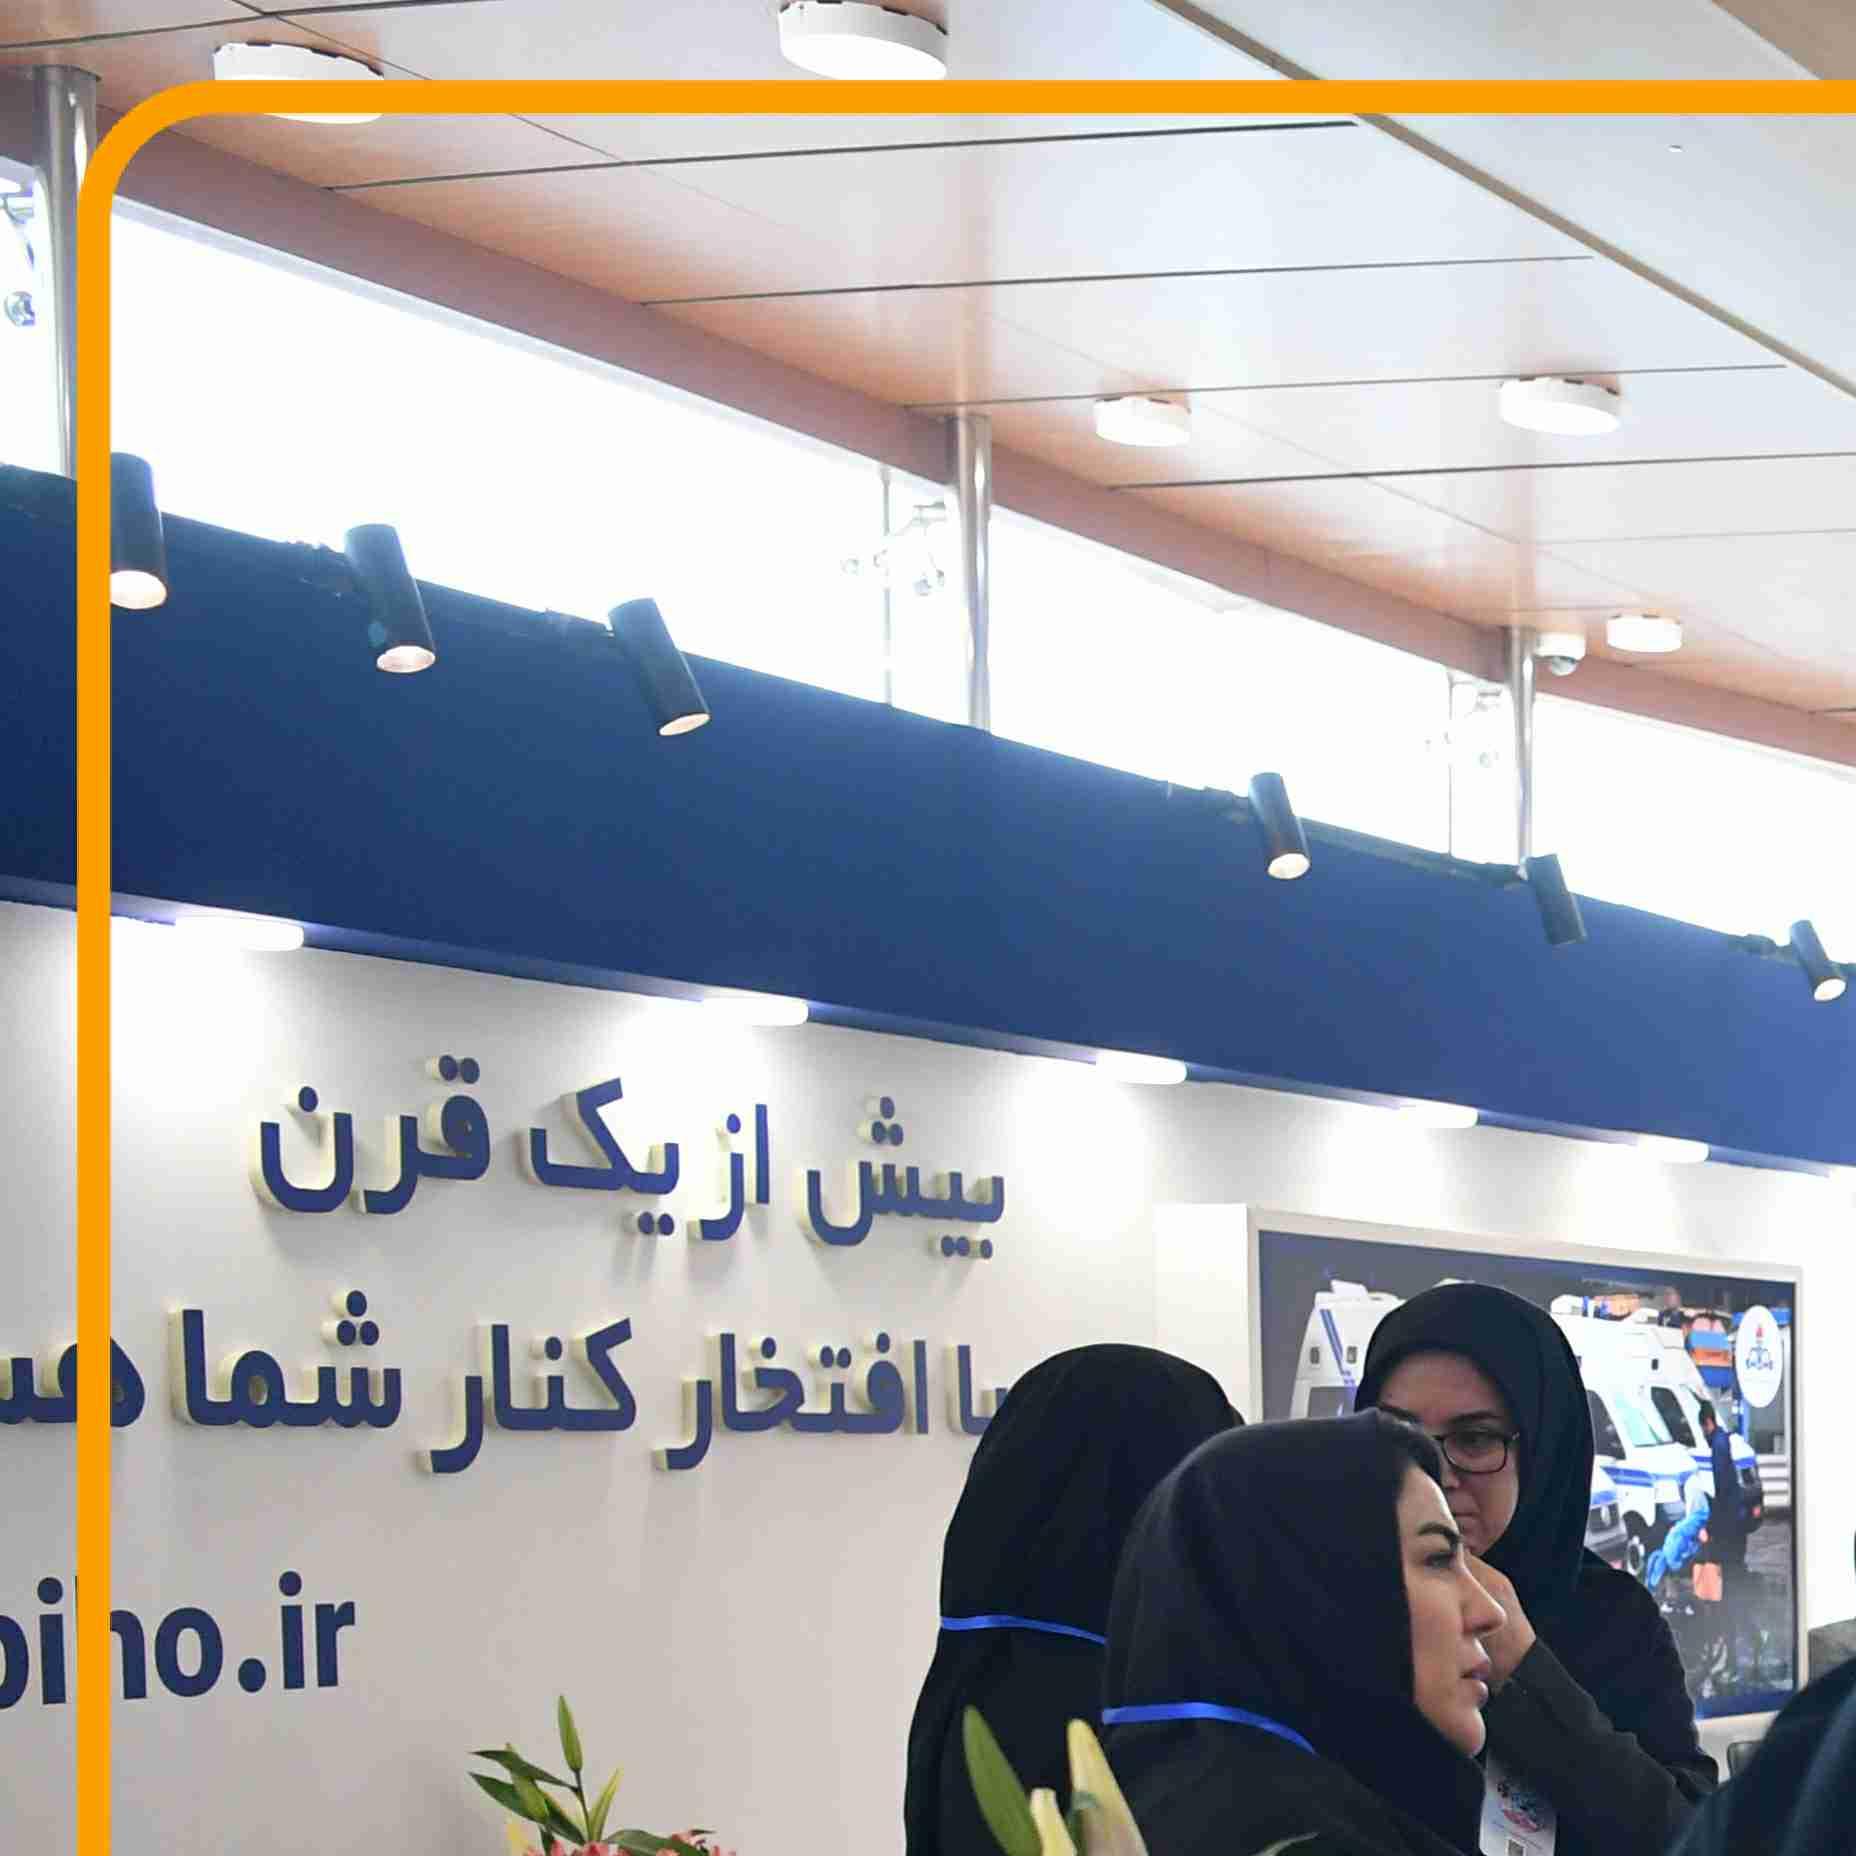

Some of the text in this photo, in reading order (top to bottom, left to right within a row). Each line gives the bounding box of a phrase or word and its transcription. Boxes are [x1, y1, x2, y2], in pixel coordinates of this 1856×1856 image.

[260, 1054, 1004, 1259] بیش از یک قرن
[182, 1290, 402, 1429] شما
[429, 1318, 637, 1474] کنار
[665, 1332, 929, 1471] افتخار
